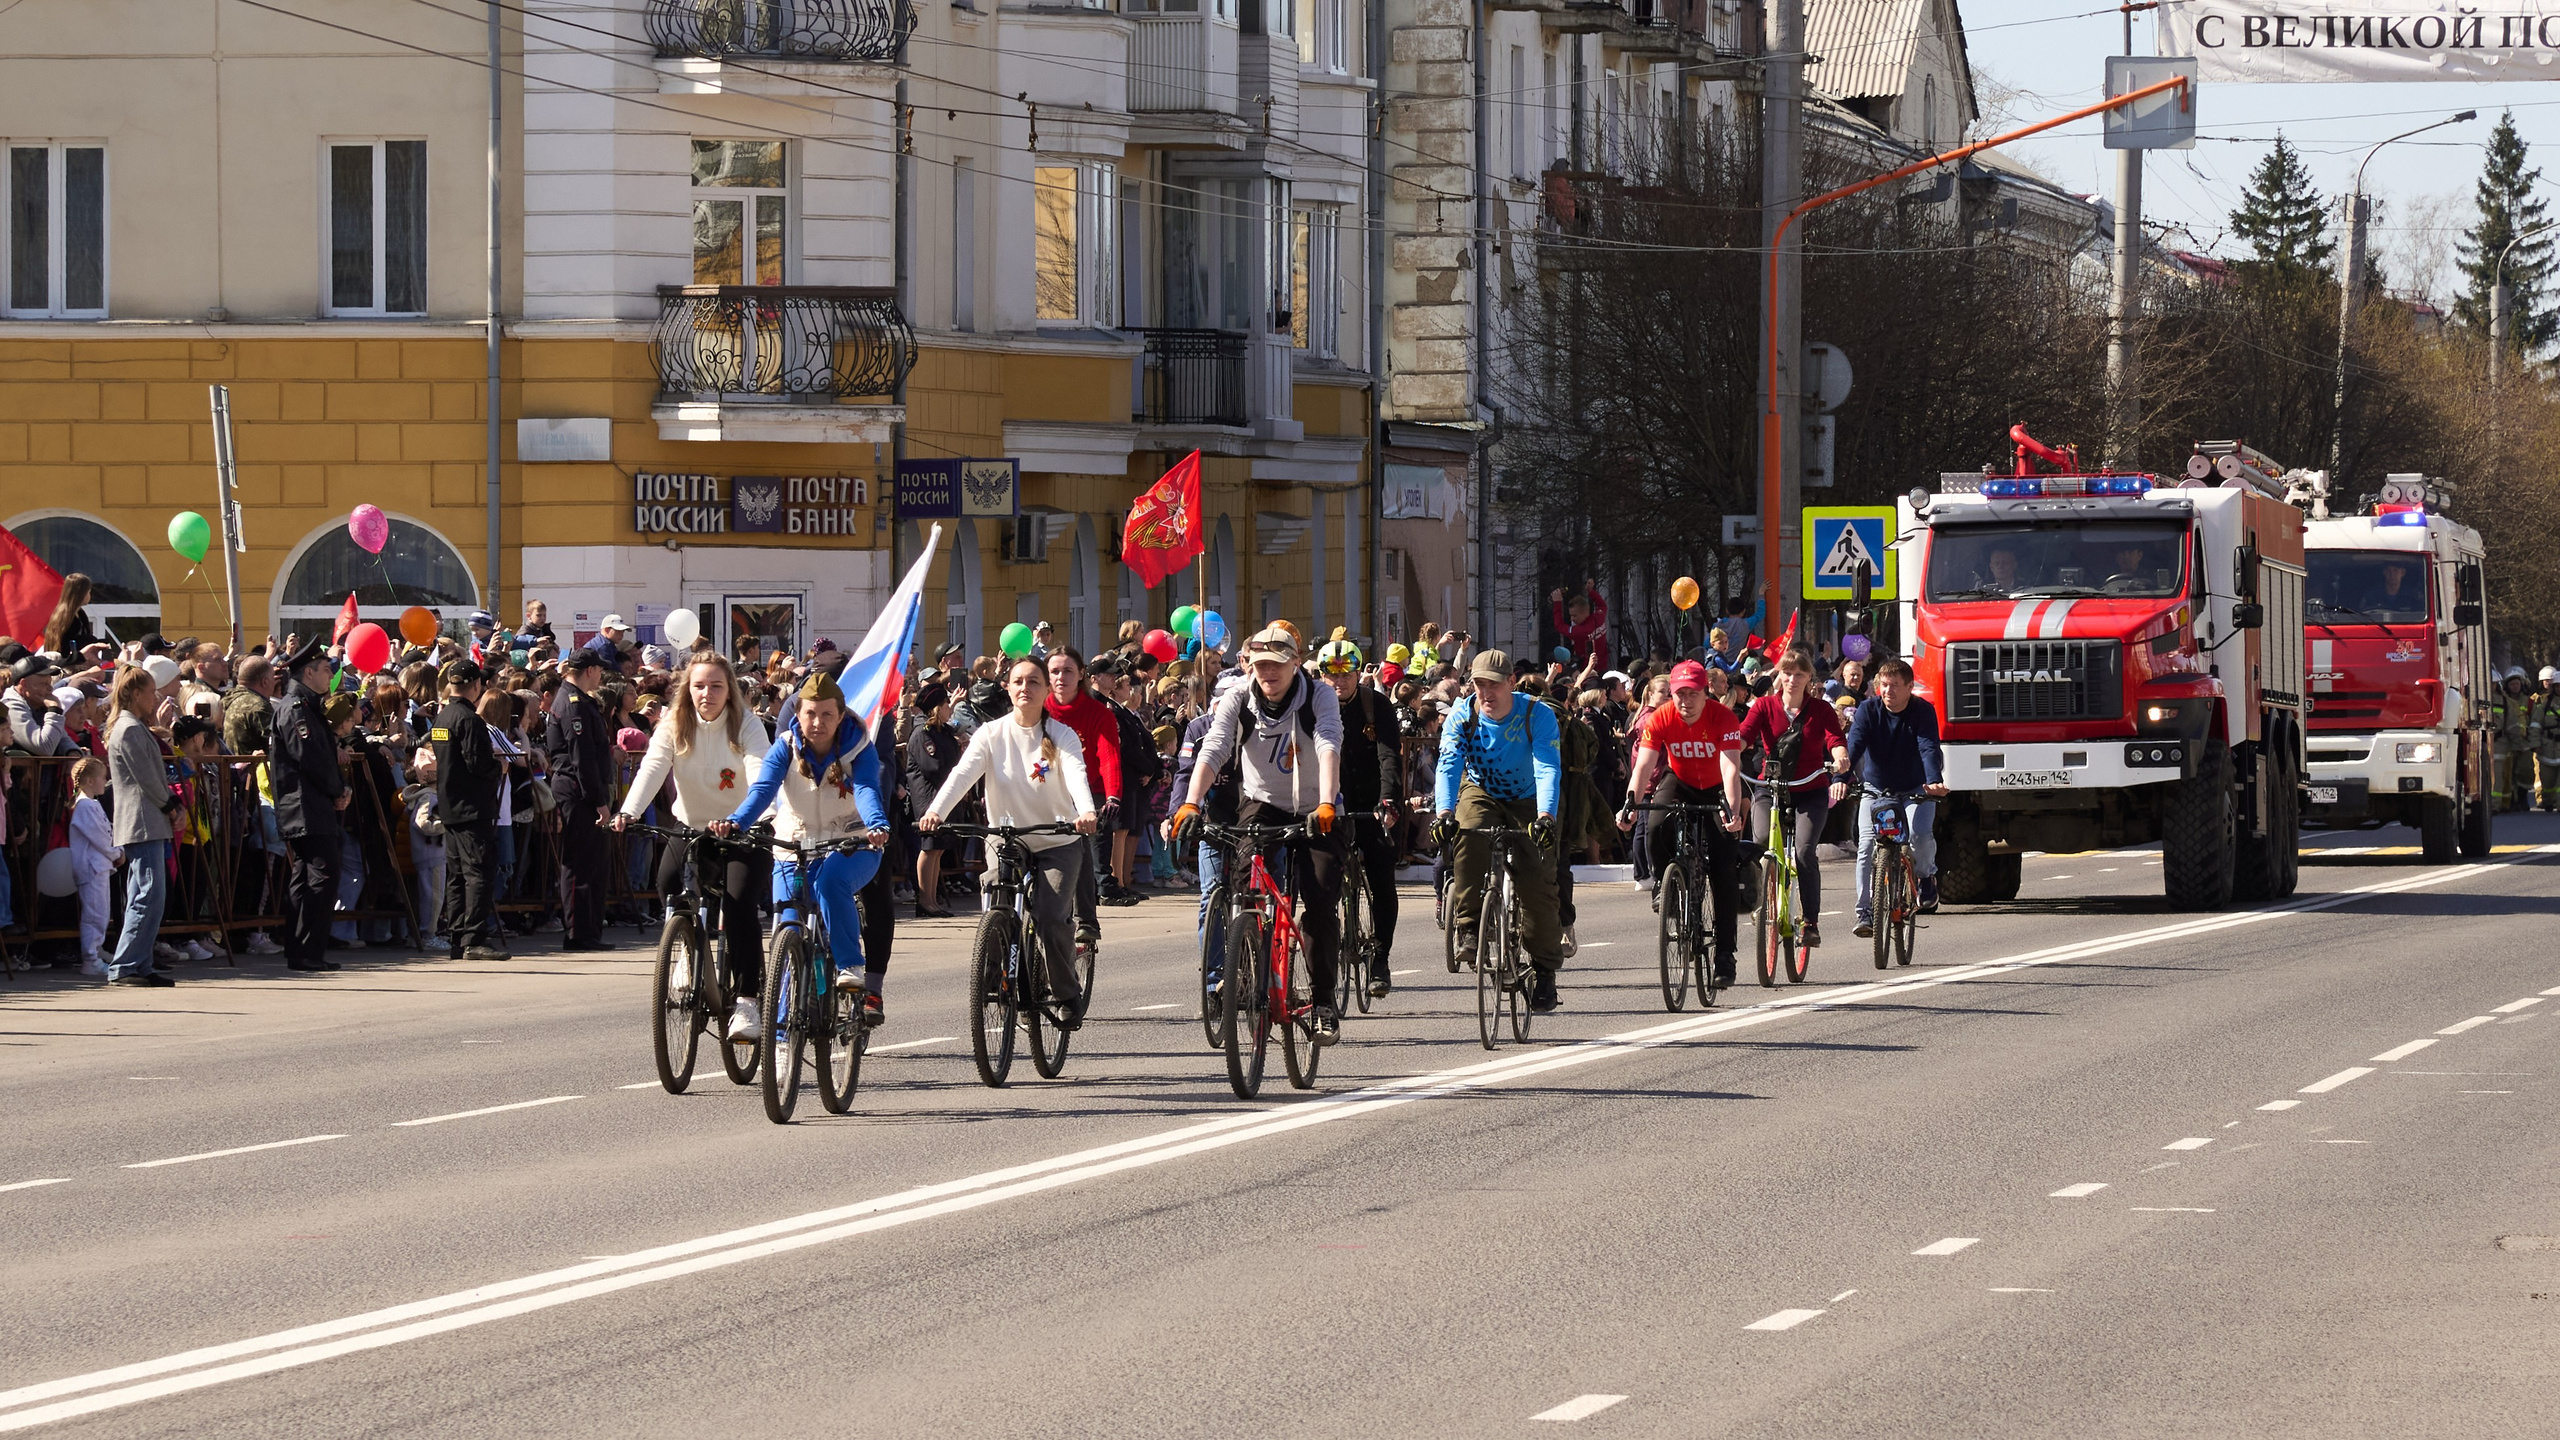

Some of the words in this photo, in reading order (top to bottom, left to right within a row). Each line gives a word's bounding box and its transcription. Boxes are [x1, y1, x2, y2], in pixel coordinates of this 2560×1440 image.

[2196, 15, 2225, 48] С
[2240, 7, 2486, 48] ВЕЛИКОЙ
[635, 473, 719, 501] ПОЧТА
[786, 477, 868, 504] ПОЧТА
[901, 472, 948, 487] ПОЧТА
[901, 490, 950, 505] РОССИИ
[635, 505, 725, 533] РОССИИ
[786, 508, 857, 535] БАНК
[1993, 670, 2072, 683] URAL
[1670, 741, 1716, 758] СССР
[2000, 772, 2048, 786] М243НР
[2050, 771, 2068, 781] 142
